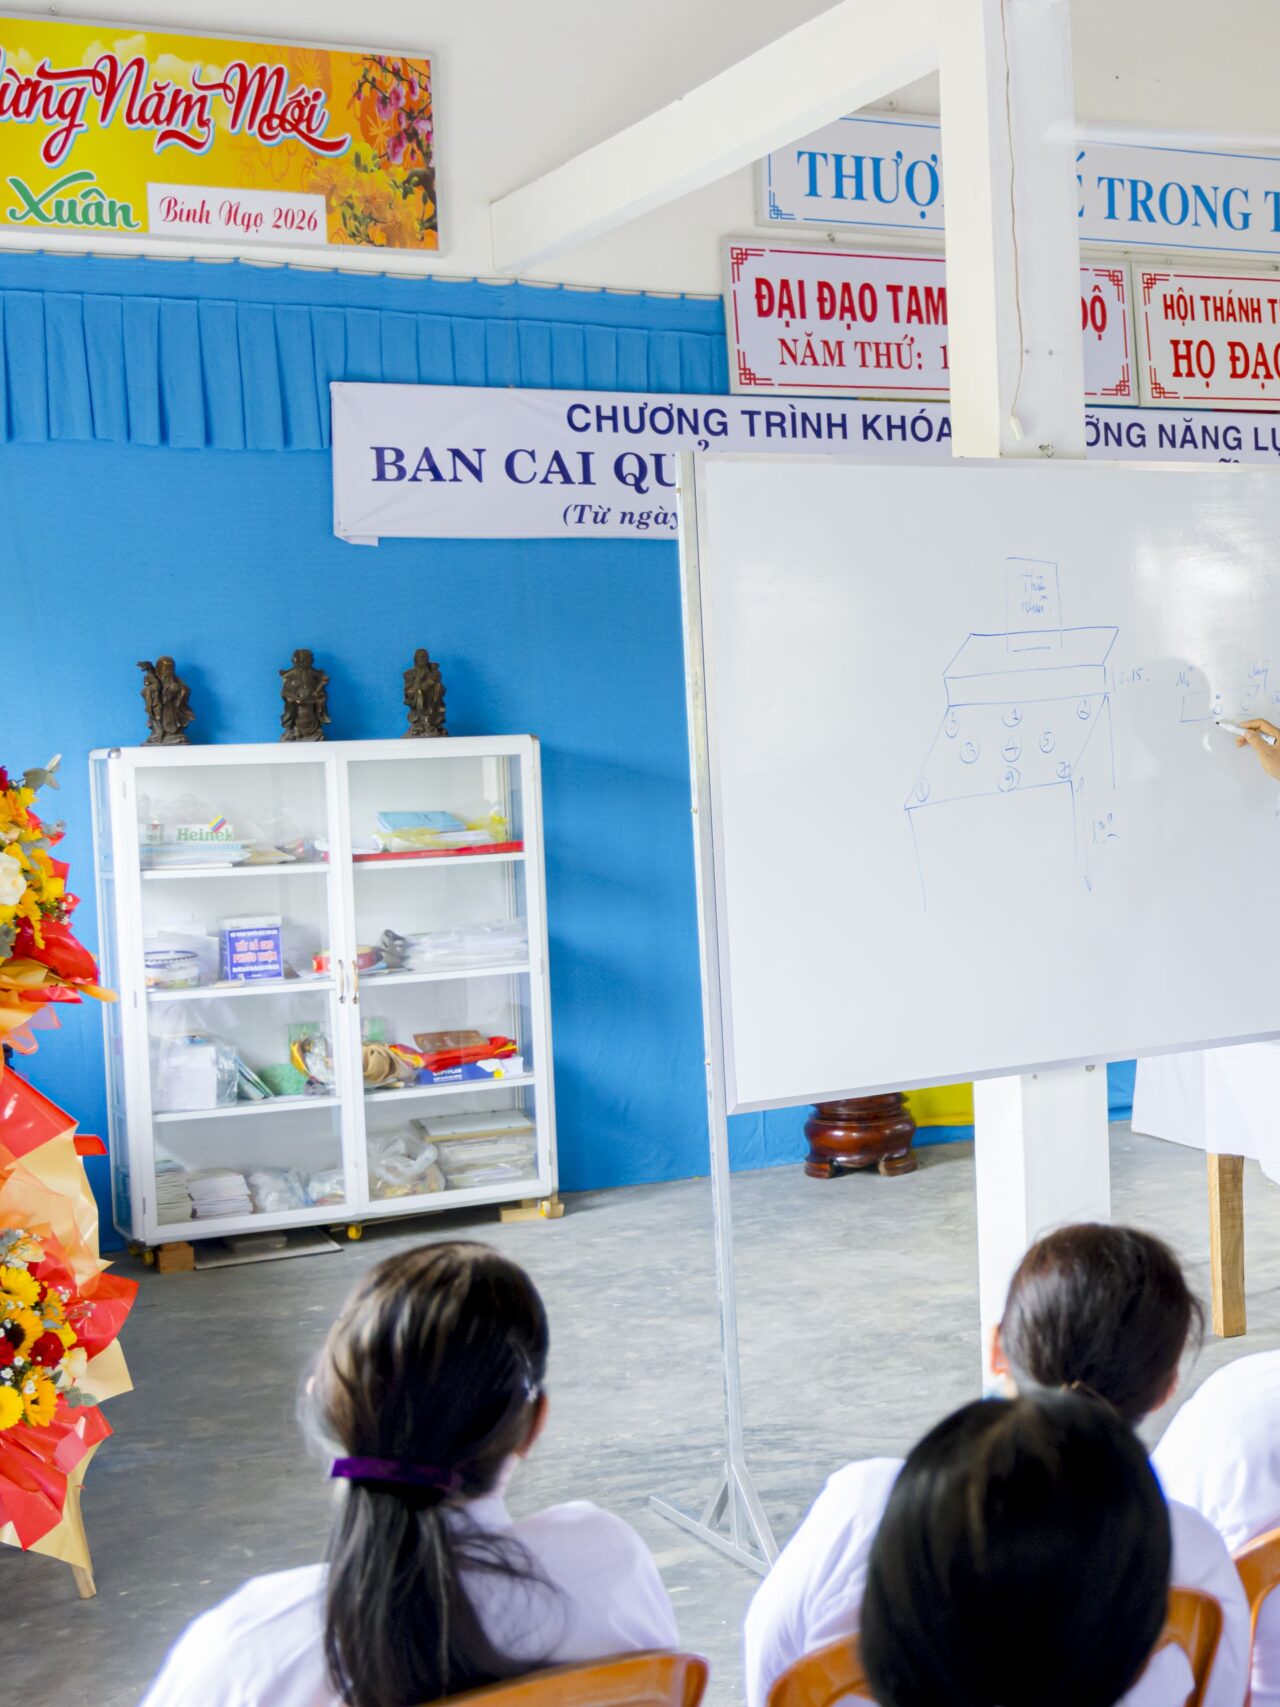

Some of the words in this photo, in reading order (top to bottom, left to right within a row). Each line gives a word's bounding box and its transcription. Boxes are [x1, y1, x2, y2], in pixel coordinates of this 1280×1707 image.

[0, 50, 88, 164] ừng
[37, 55, 211, 150] Năm
[192, 63, 349, 152] Mới
[9, 171, 140, 228] Xuân
[797, 149, 944, 220] THƯỢ
[1097, 176, 1252, 232] TRONG
[219, 200, 264, 233] Ngọ
[272, 207, 318, 232] 2026
[755, 277, 807, 328] ĐẠI
[816, 280, 878, 331] ĐẠO
[886, 284, 948, 326] TAM
[1163, 287, 1195, 327] HỘI
[1200, 289, 1262, 324] THÁNH
[777, 331, 846, 368] NĂM
[854, 334, 922, 370] THỨ:
[1170, 339, 1215, 389] HỌ
[566, 402, 729, 437] CHƯƠNG
[740, 404, 848, 440] TRÌNH
[862, 408, 952, 443] KHÓA
[1085, 414, 1146, 448] ỠNG
[1158, 417, 1242, 452] NĂNG
[370, 446, 486, 483] BAN
[504, 448, 596, 486] CAI
[563, 504, 612, 526] (Từ
[620, 505, 678, 530] ngày
